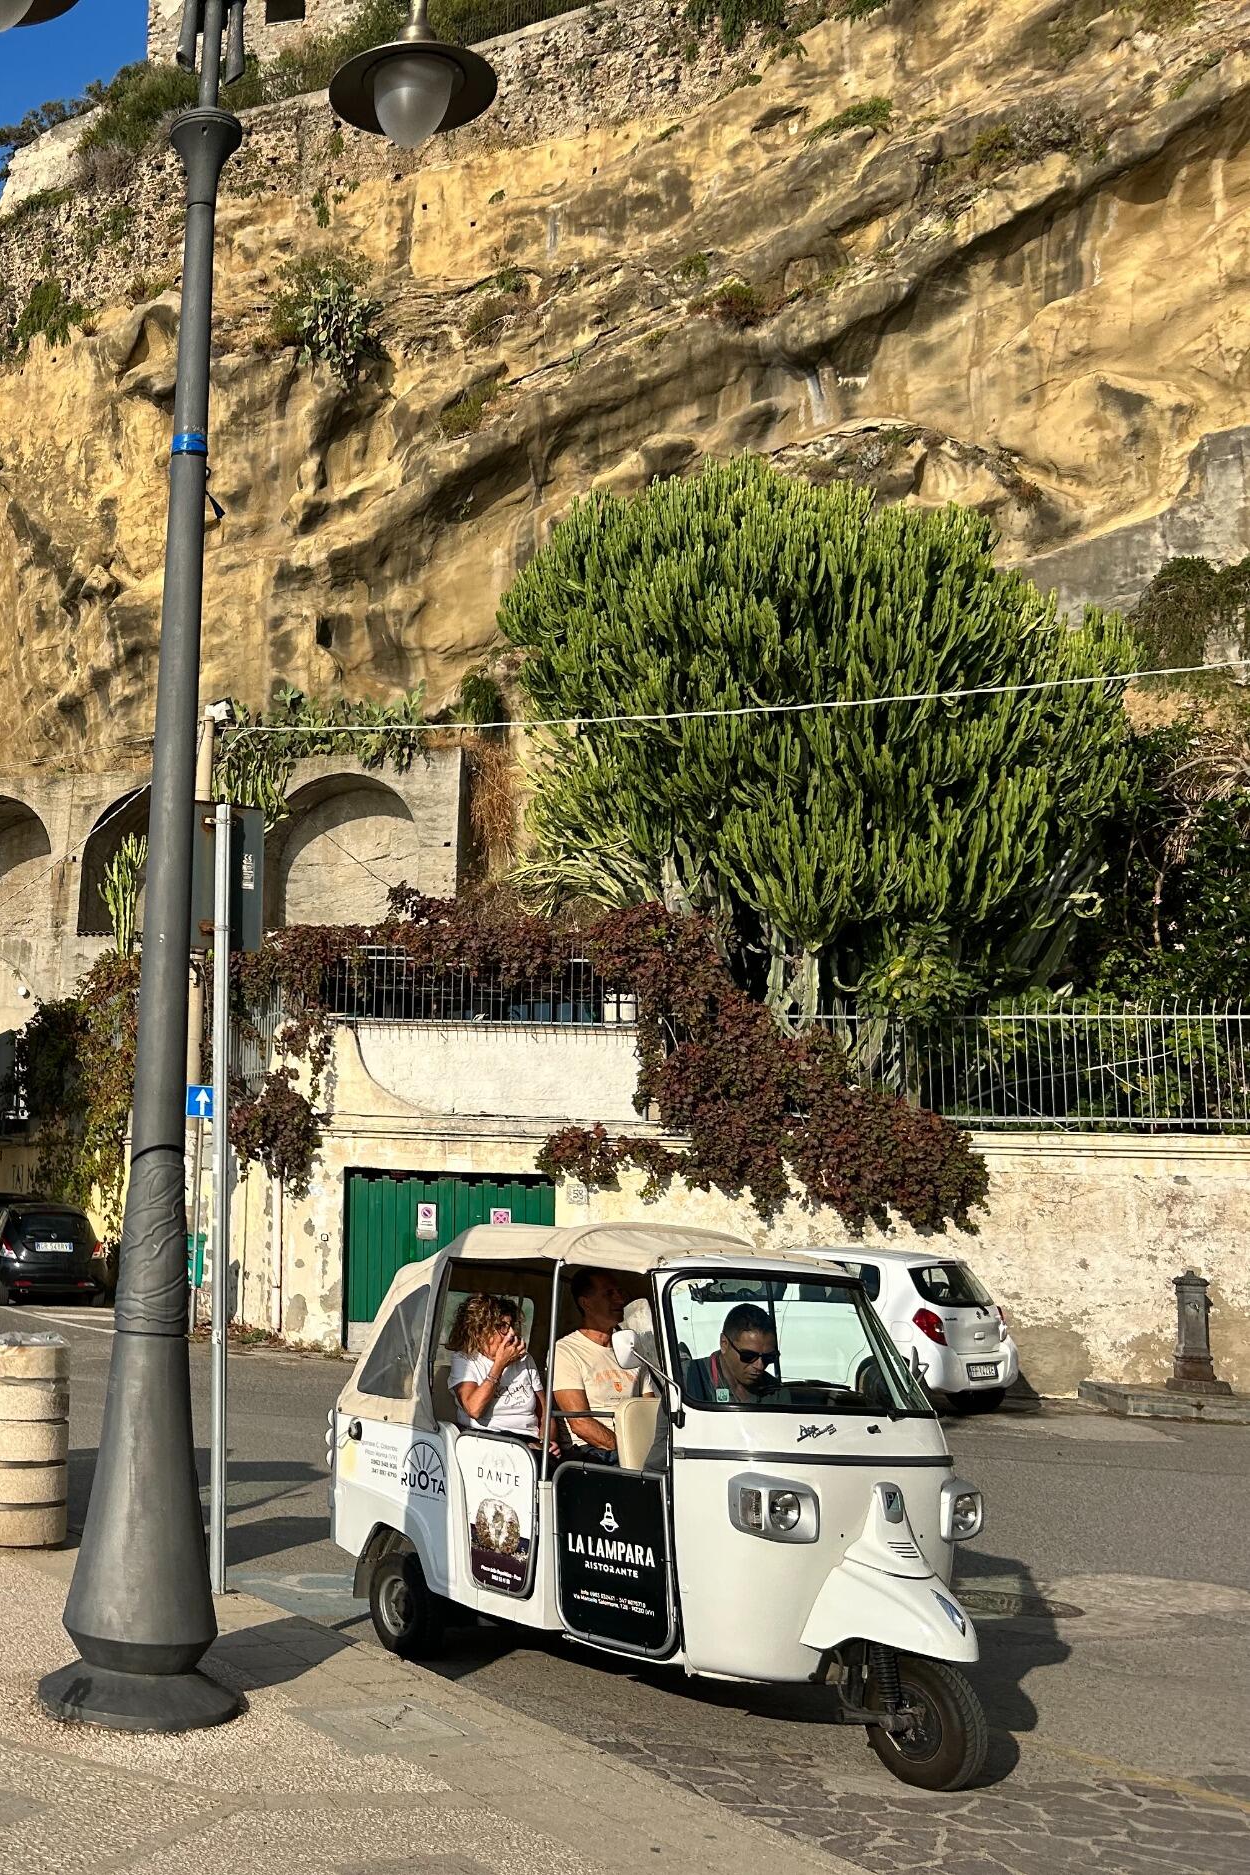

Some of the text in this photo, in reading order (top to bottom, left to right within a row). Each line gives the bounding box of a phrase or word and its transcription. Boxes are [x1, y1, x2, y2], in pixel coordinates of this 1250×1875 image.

[400, 1469, 447, 1497] RUOTA
[477, 1466, 520, 1487] DANTE
[567, 1532, 656, 1568] LA LAMPARA
[584, 1560, 639, 1579] RISTORANTE
